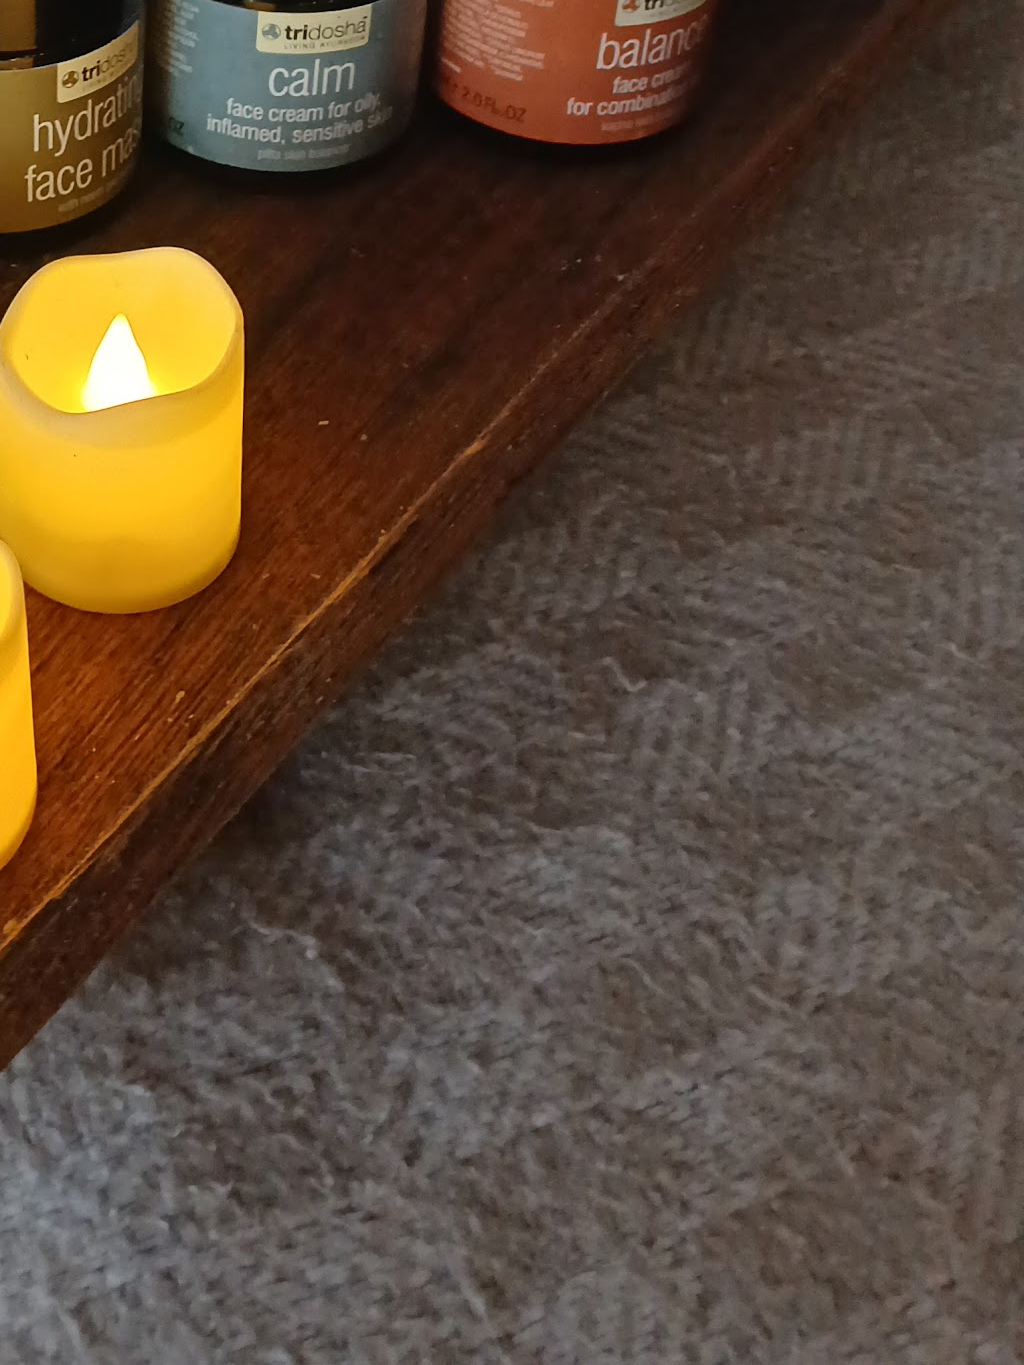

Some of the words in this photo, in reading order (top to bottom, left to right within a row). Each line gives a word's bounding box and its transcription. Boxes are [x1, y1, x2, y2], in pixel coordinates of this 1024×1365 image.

[284, 18, 367, 41] tridosha
[81, 45, 133, 82] tridos
[268, 58, 355, 97] calm
[612, 76, 648, 94] face
[226, 97, 264, 121] face
[268, 106, 324, 123] cream
[328, 101, 352, 119] for
[567, 97, 593, 116] for
[206, 113, 286, 145] inflamed,
[292, 119, 364, 144] sensitive
[24, 159, 93, 203] face
